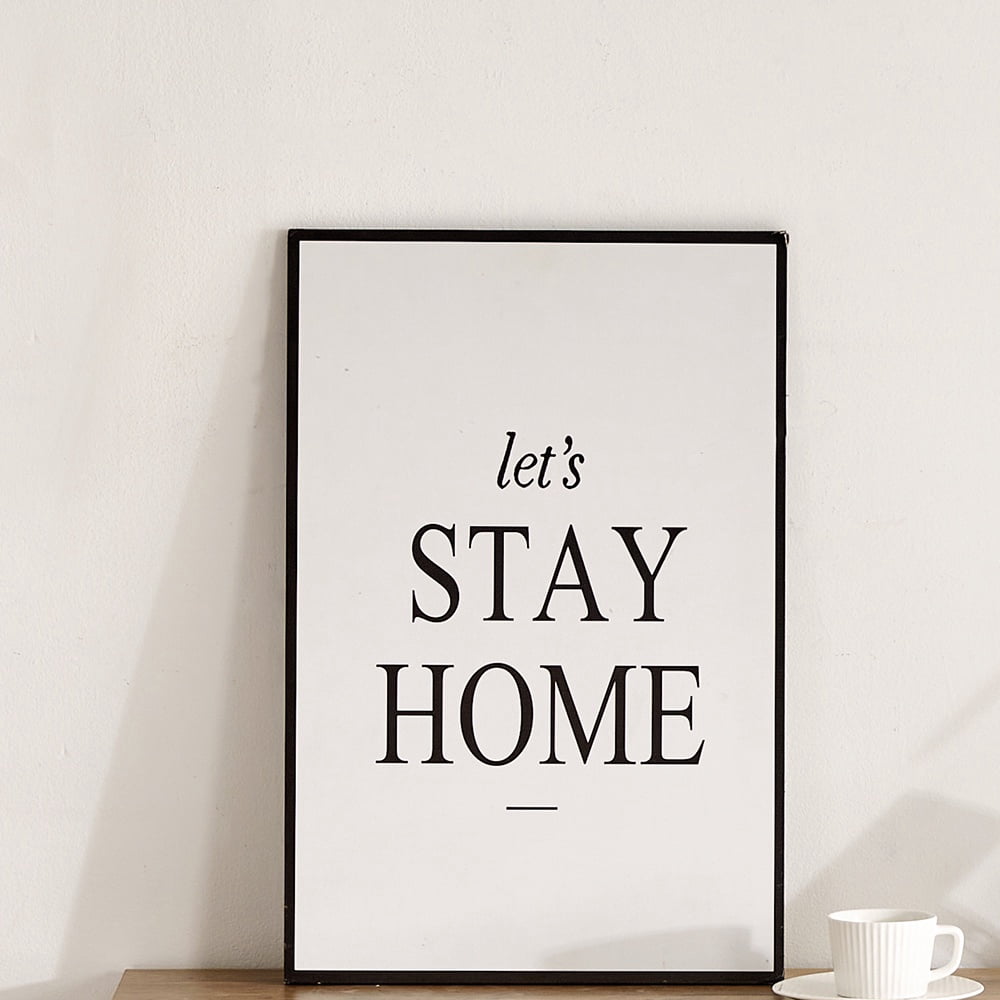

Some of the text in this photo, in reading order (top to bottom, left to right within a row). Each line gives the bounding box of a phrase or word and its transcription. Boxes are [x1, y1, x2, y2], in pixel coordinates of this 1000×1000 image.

[496, 431, 585, 490] let’s
[411, 522, 688, 624] STAY
[375, 662, 706, 767] HOME
